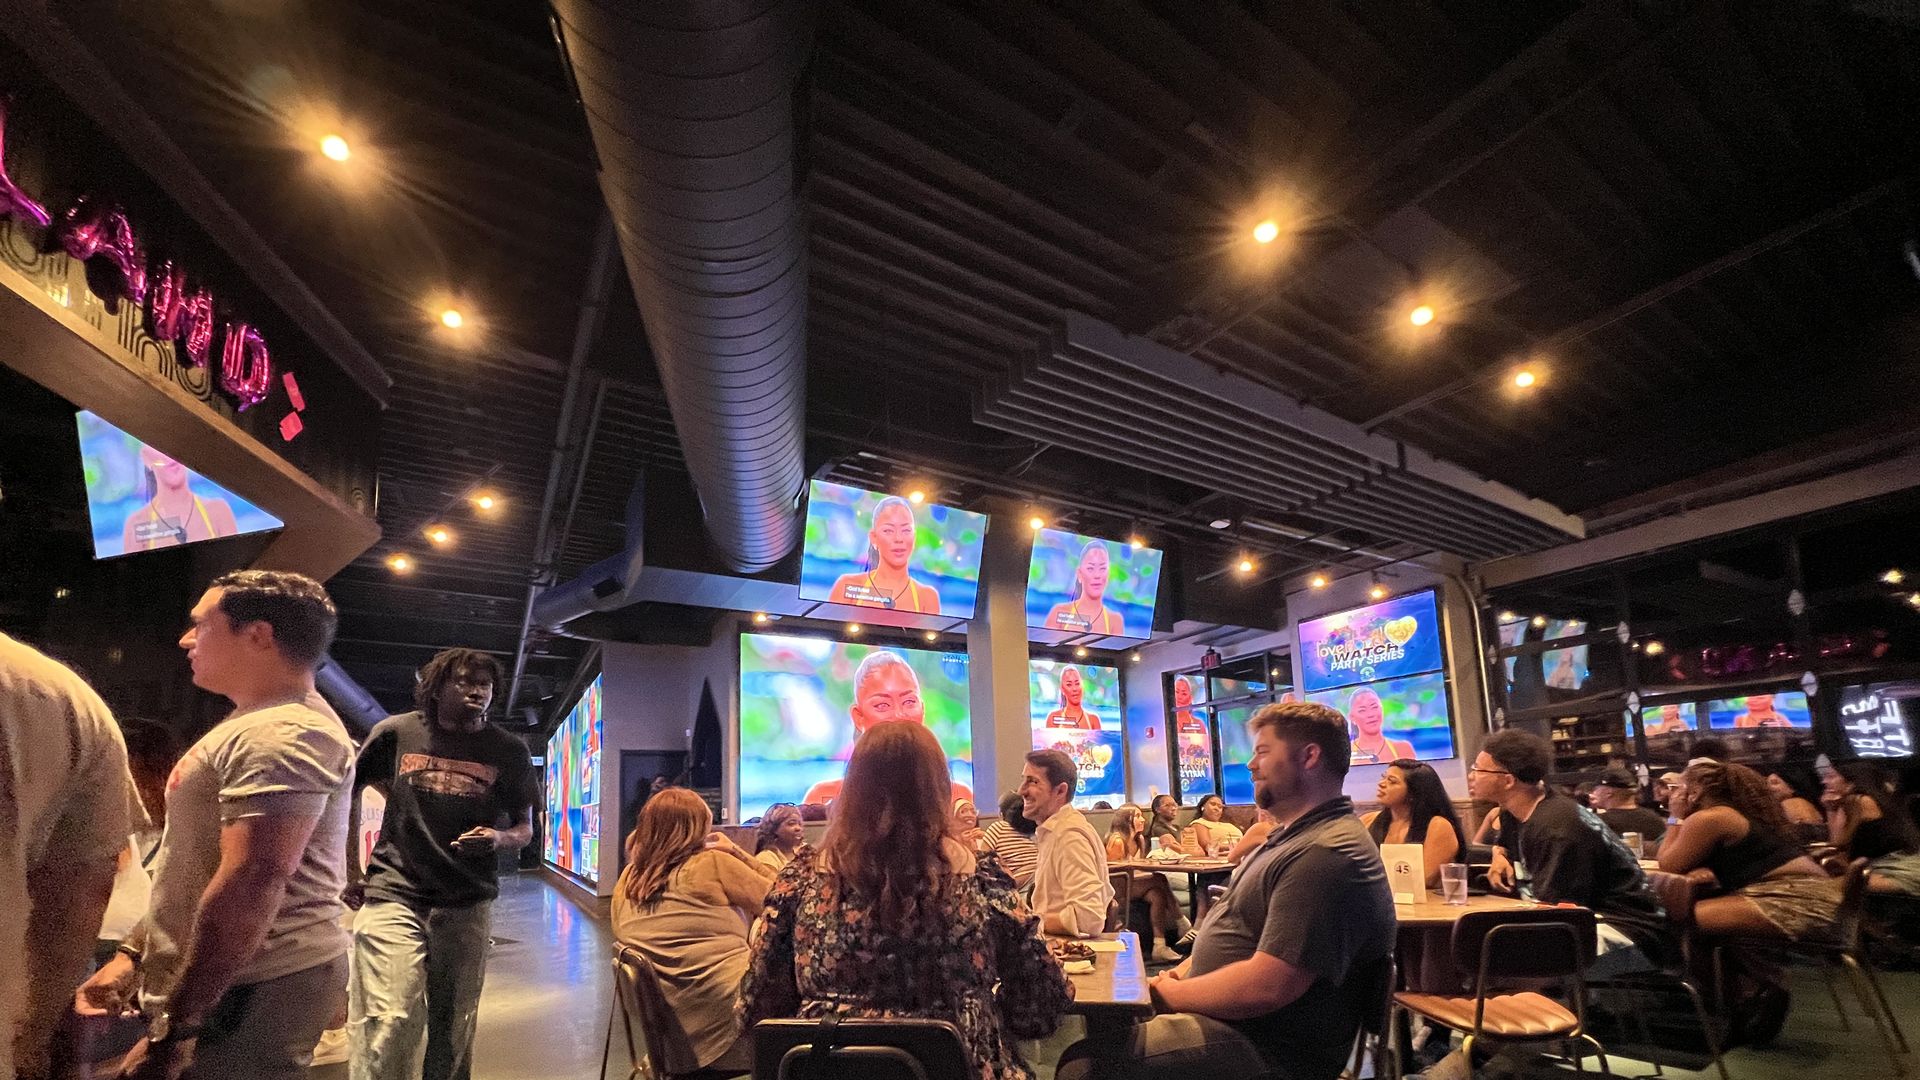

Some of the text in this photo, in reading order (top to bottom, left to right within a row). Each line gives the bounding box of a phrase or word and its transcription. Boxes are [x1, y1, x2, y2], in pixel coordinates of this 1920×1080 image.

[1330, 648, 1405, 671] PARTY SERIES
[1334, 643, 1399, 663] WATCH
[1395, 864, 1410, 875] 45
